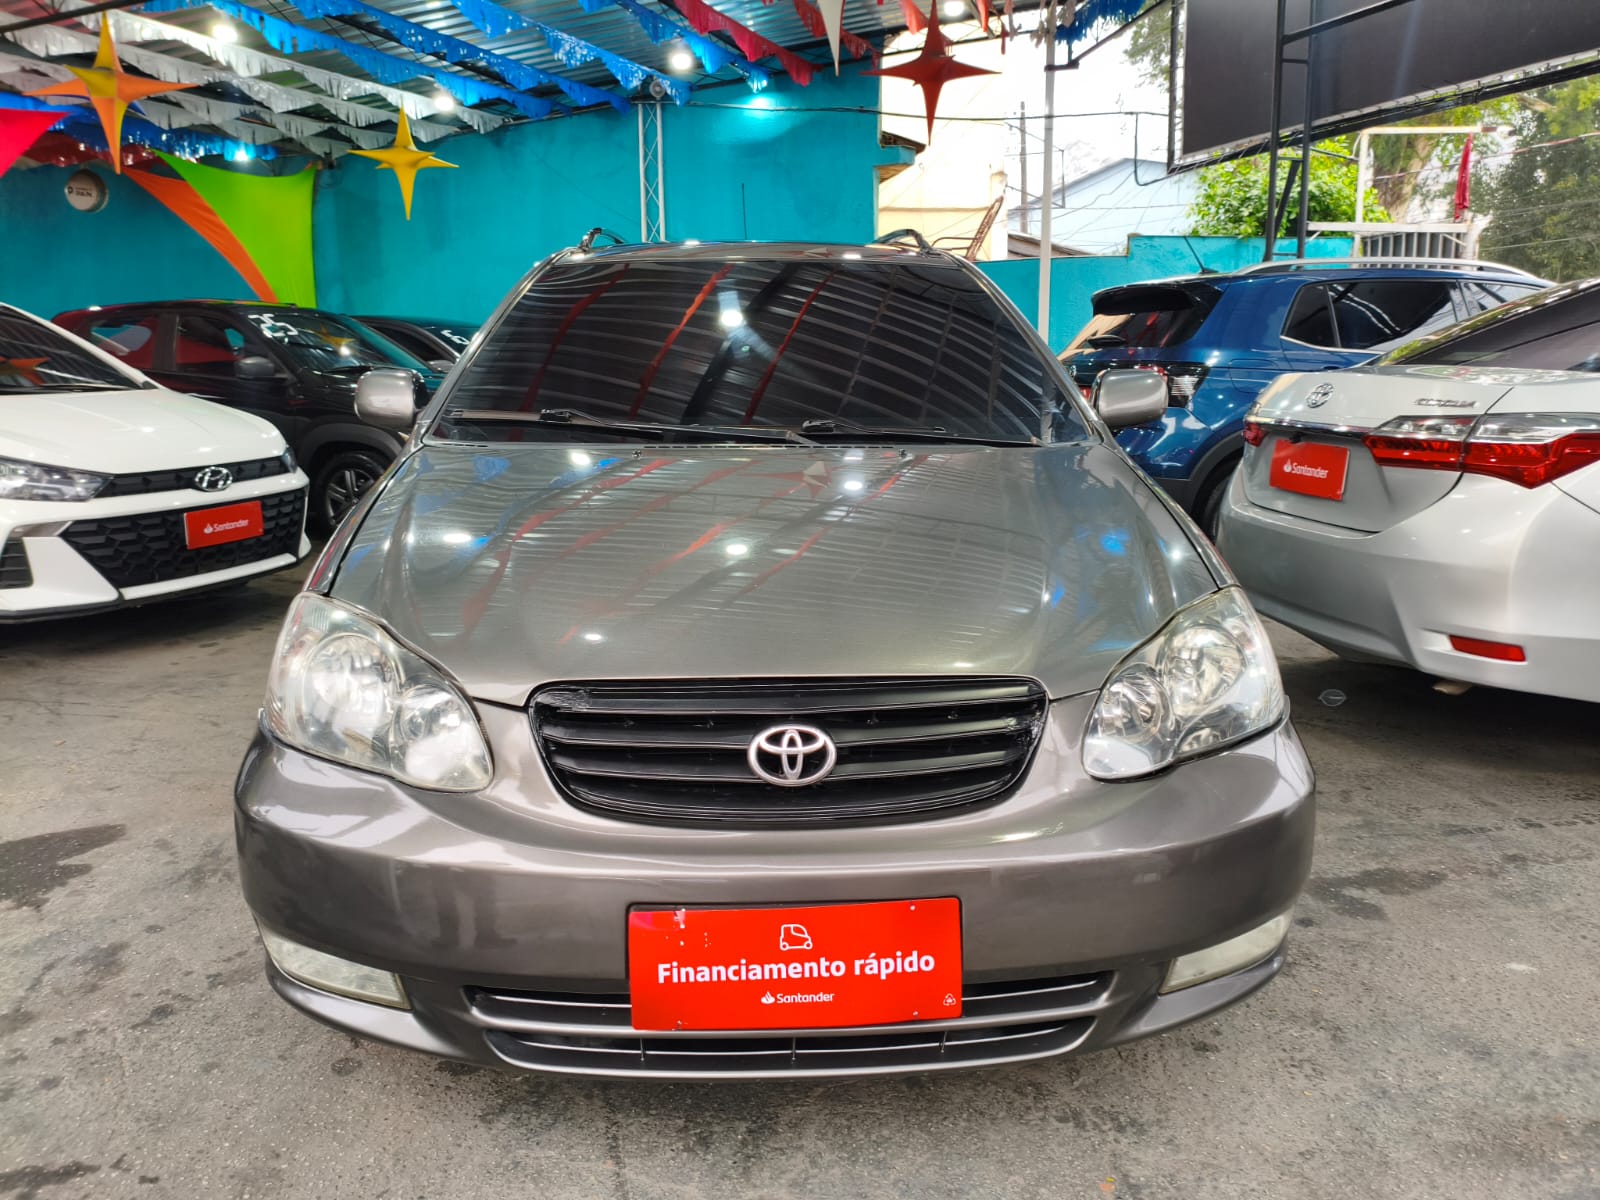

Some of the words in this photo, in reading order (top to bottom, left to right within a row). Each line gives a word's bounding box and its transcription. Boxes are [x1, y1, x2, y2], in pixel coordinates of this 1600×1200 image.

[247, 313, 299, 338] 25
[1291, 462, 1329, 479] Santander
[212, 519, 249, 532] Santander
[657, 957, 846, 984] Financiamento
[854, 950, 935, 980] rápido
[776, 992, 835, 1004] Santander
